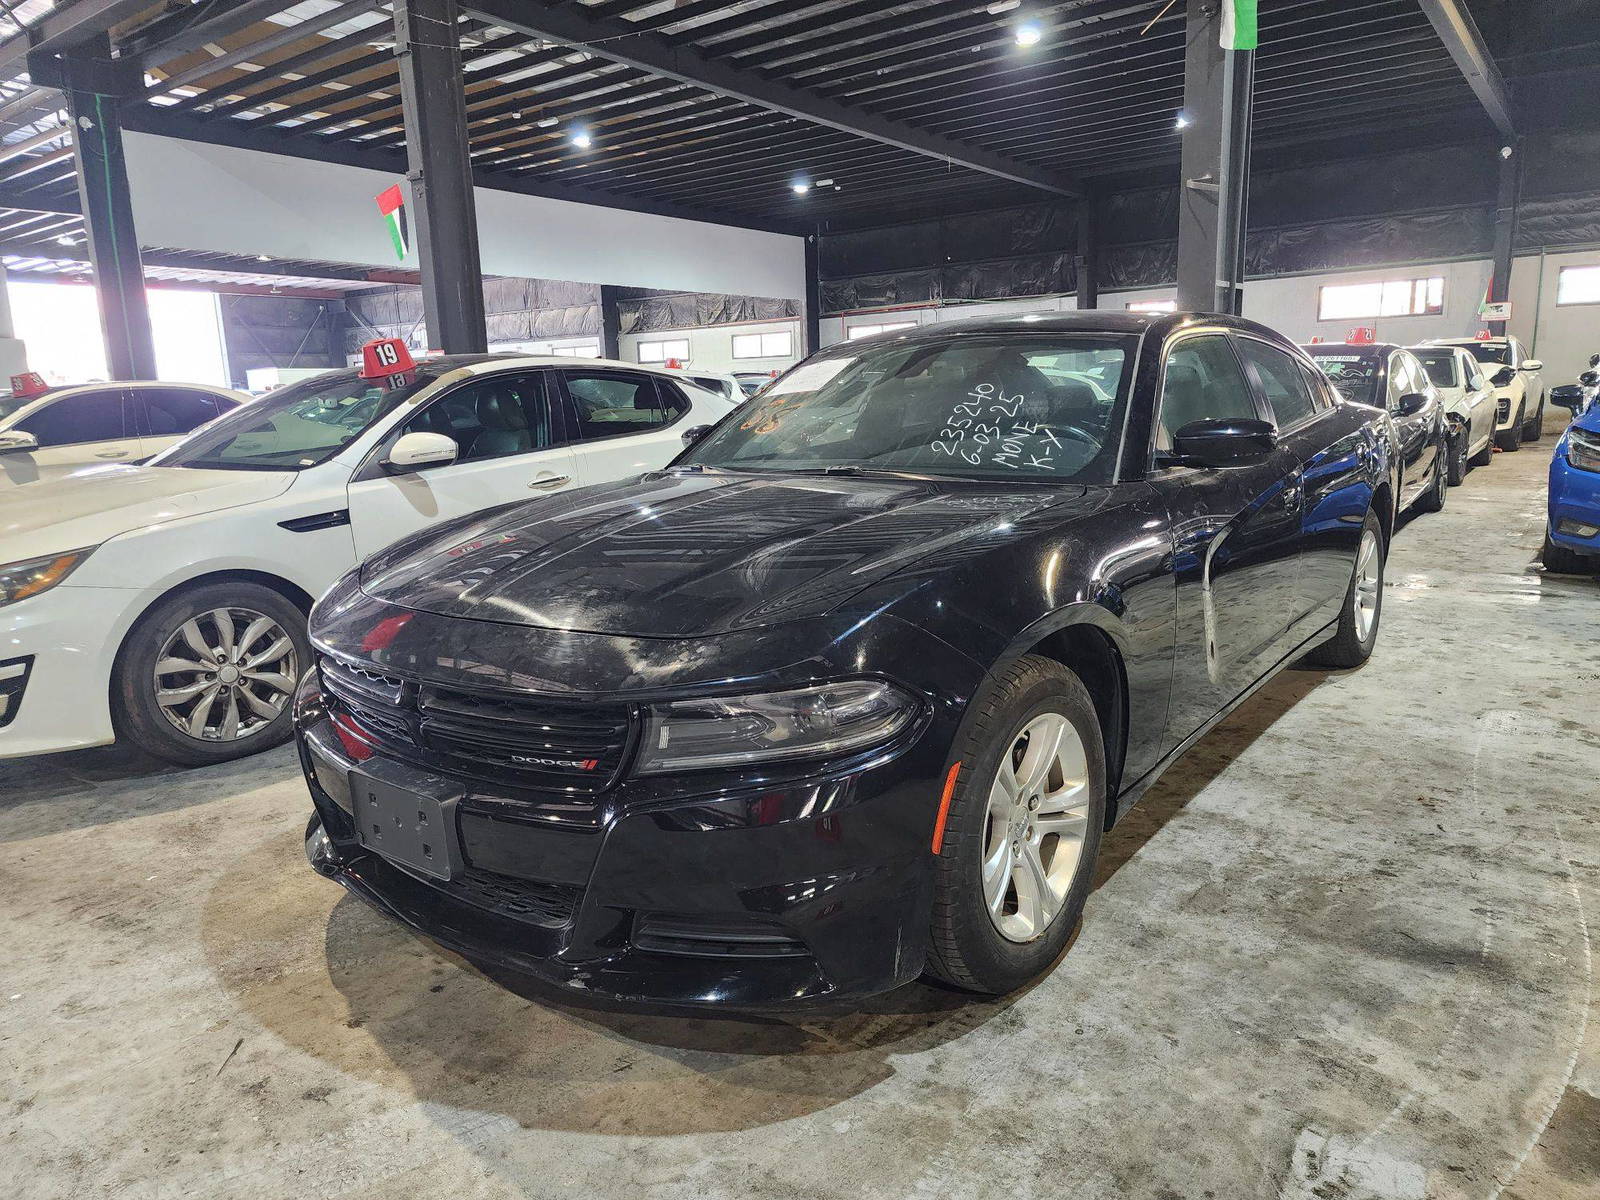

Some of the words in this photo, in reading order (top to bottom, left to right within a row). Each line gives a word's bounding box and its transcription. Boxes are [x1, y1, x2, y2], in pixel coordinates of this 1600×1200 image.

[376, 343, 398, 366] 19
[931, 383, 994, 455] 235240
[961, 391, 1024, 465] 6-03-25
[511, 755, 586, 768] DODGE
